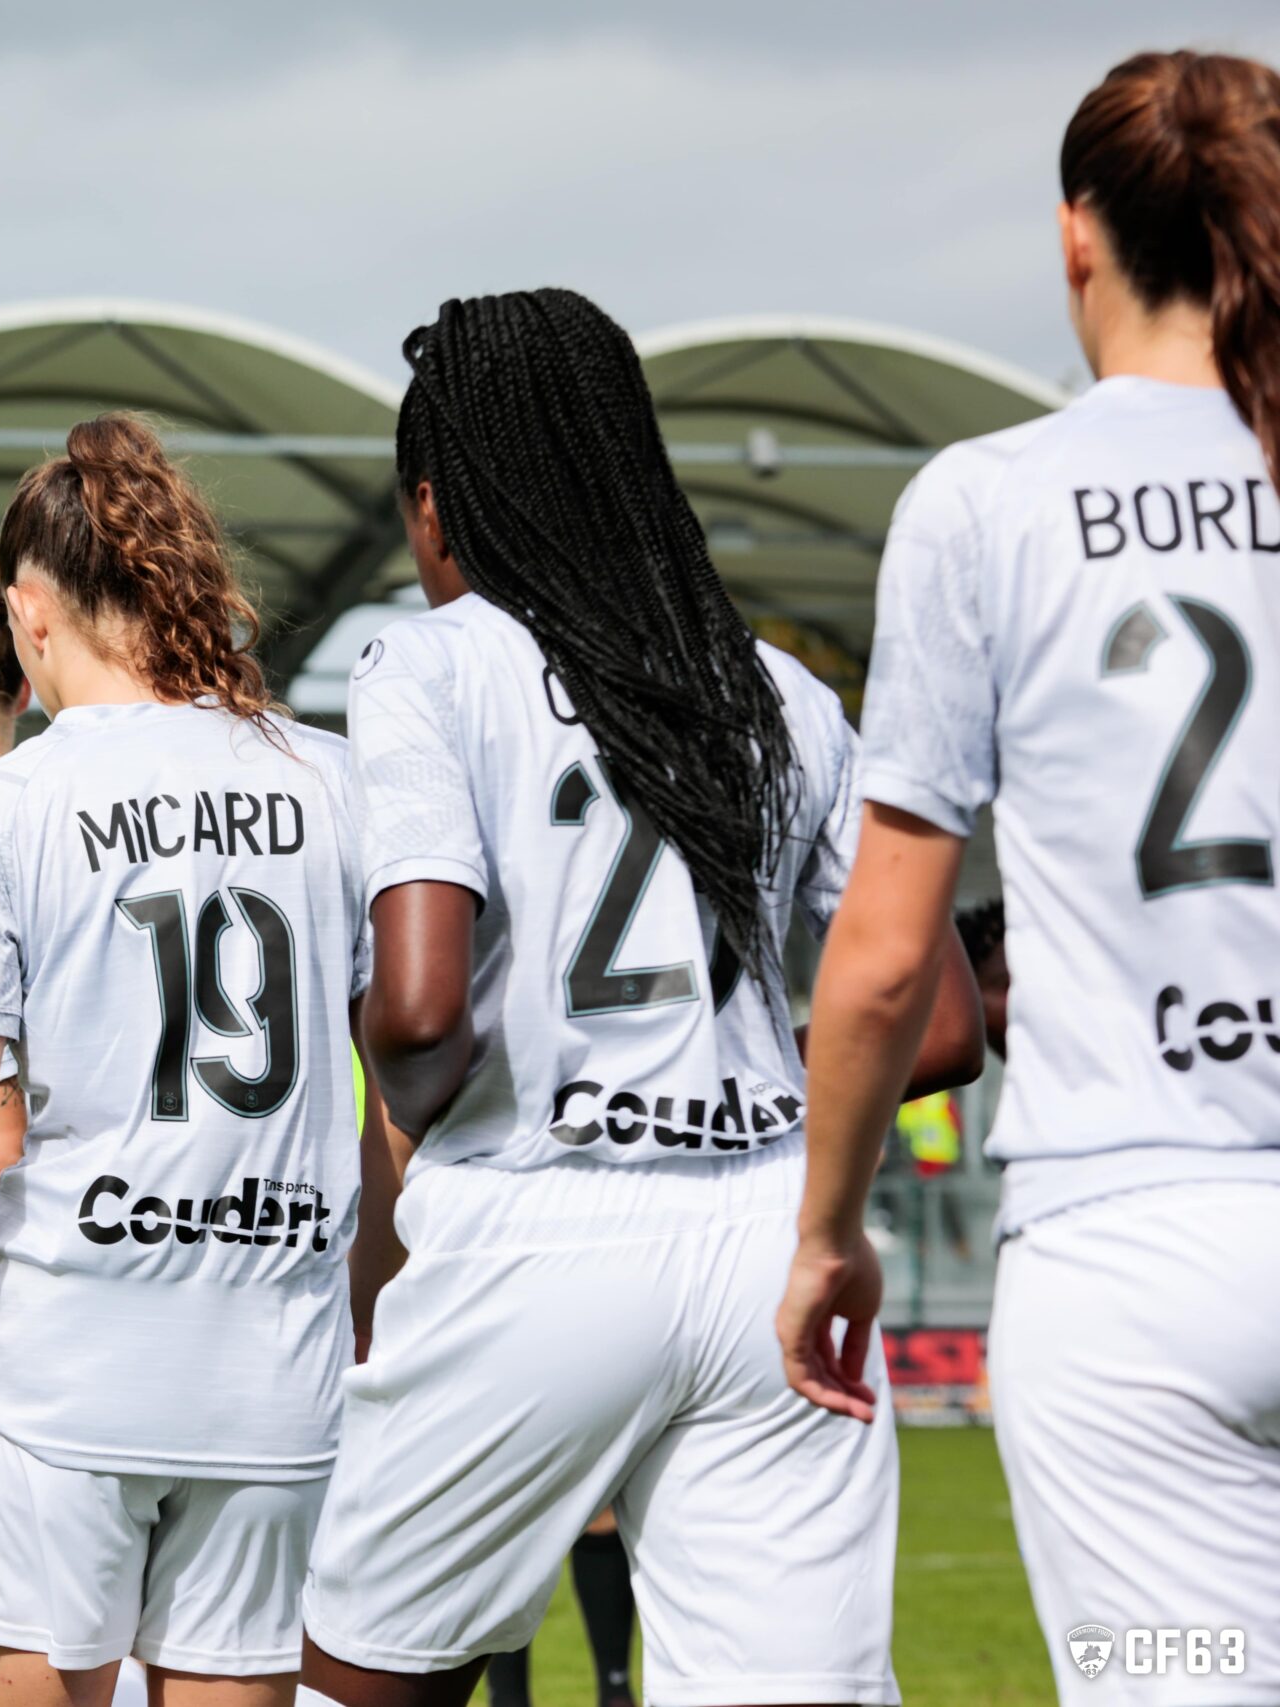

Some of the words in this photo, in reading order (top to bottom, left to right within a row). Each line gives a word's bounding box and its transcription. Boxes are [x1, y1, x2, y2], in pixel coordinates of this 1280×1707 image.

[75, 790, 306, 874] MICARD
[114, 886, 301, 1123] 19
[77, 1173, 332, 1254] Coudert
